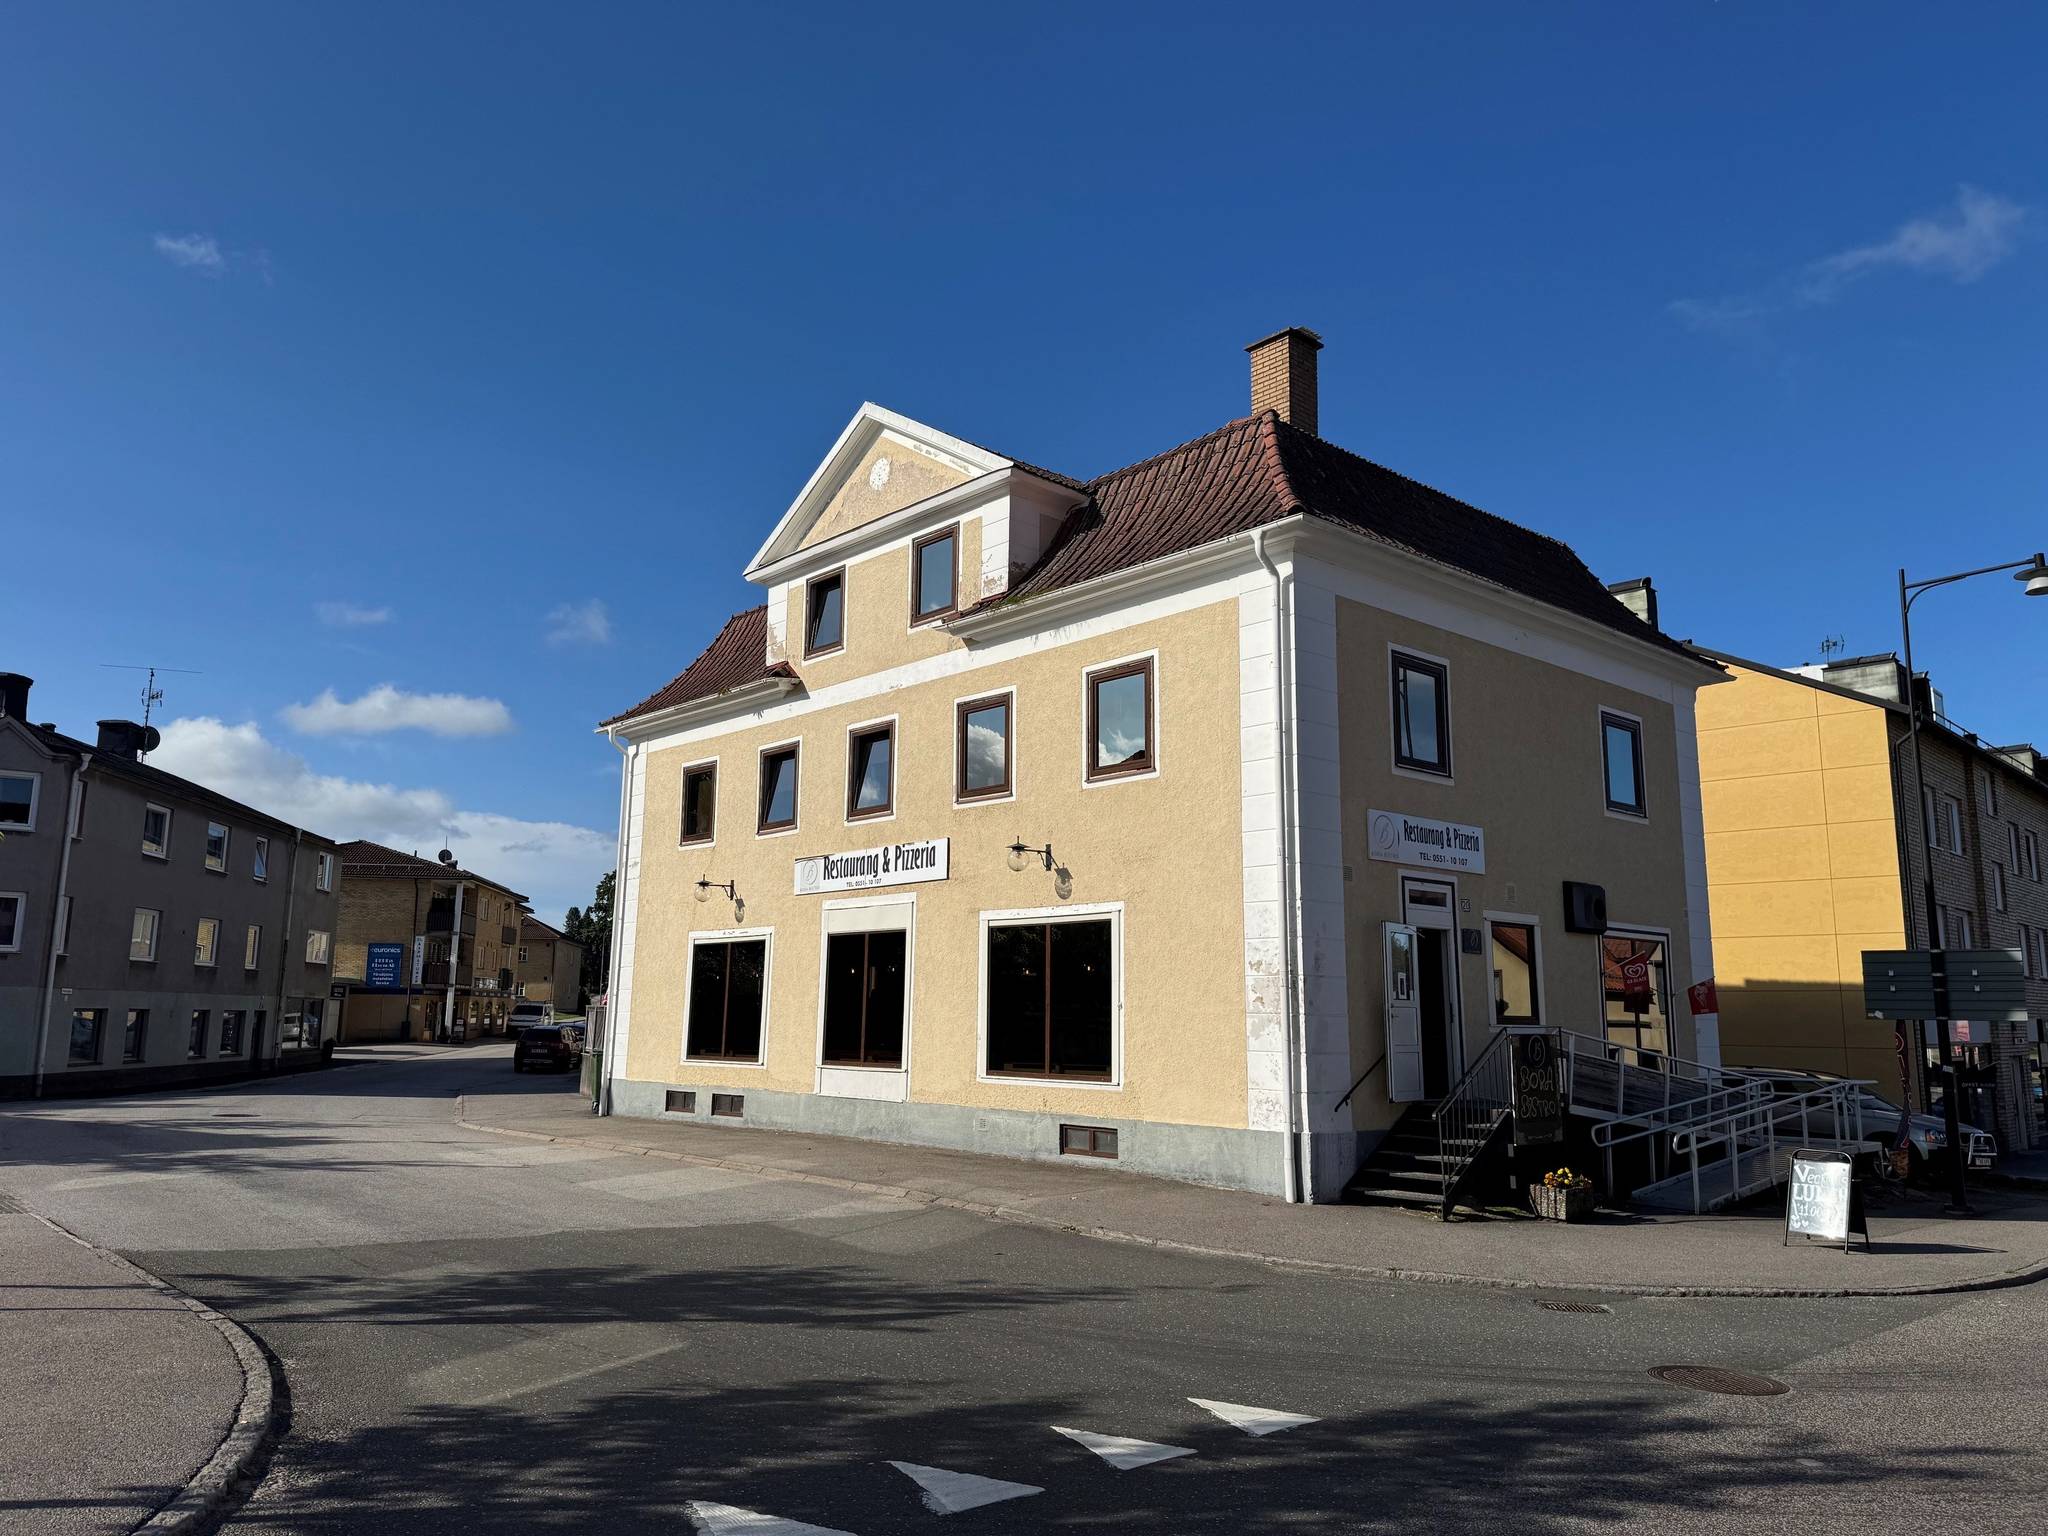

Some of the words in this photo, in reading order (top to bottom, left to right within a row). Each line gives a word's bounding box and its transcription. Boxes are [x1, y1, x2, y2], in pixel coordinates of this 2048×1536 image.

[1403, 819, 1445, 849] Restaurang
[1445, 827, 1452, 848] &
[1453, 828, 1480, 852] Pizzeria
[823, 853, 879, 881] Restaurang
[883, 846, 890, 873] &
[894, 841, 936, 872] Pizzeria
[1450, 856, 1457, 865] 10
[1458, 857, 1468, 866] 107
[1520, 1065, 1554, 1092] BORA
